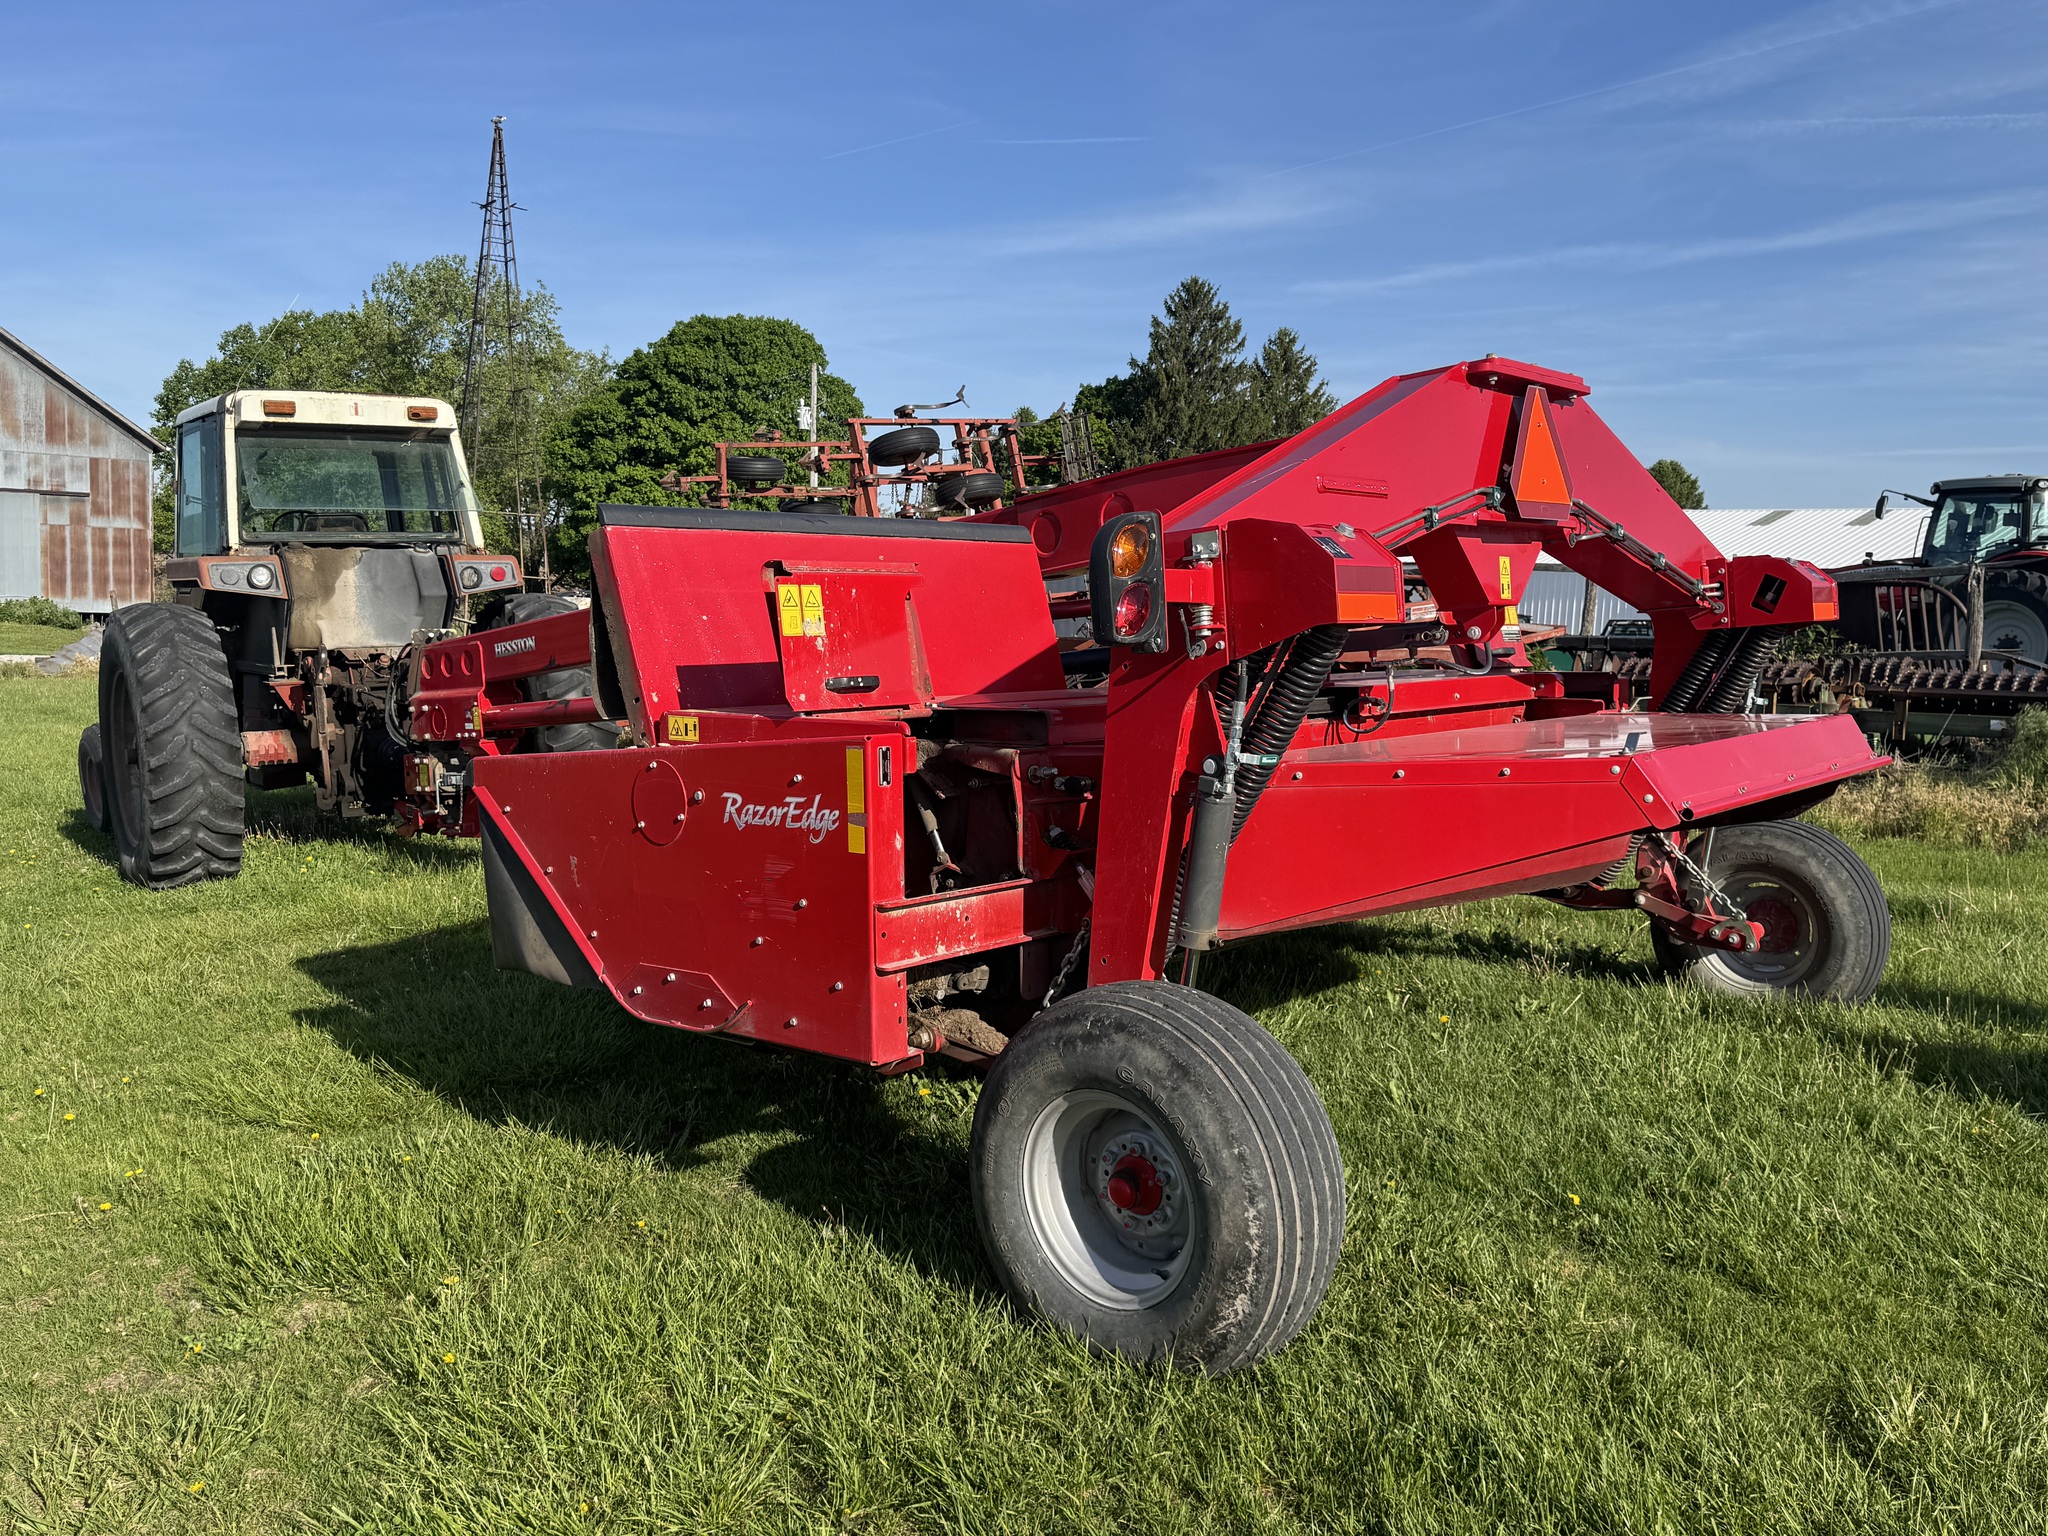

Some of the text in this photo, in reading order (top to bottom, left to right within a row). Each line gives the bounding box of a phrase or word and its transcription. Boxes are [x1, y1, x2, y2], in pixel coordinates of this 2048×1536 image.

[494, 636, 536, 658] HESSTON
[721, 791, 840, 844] RazorEdge
[1116, 1065, 1213, 1187] GALAXY
